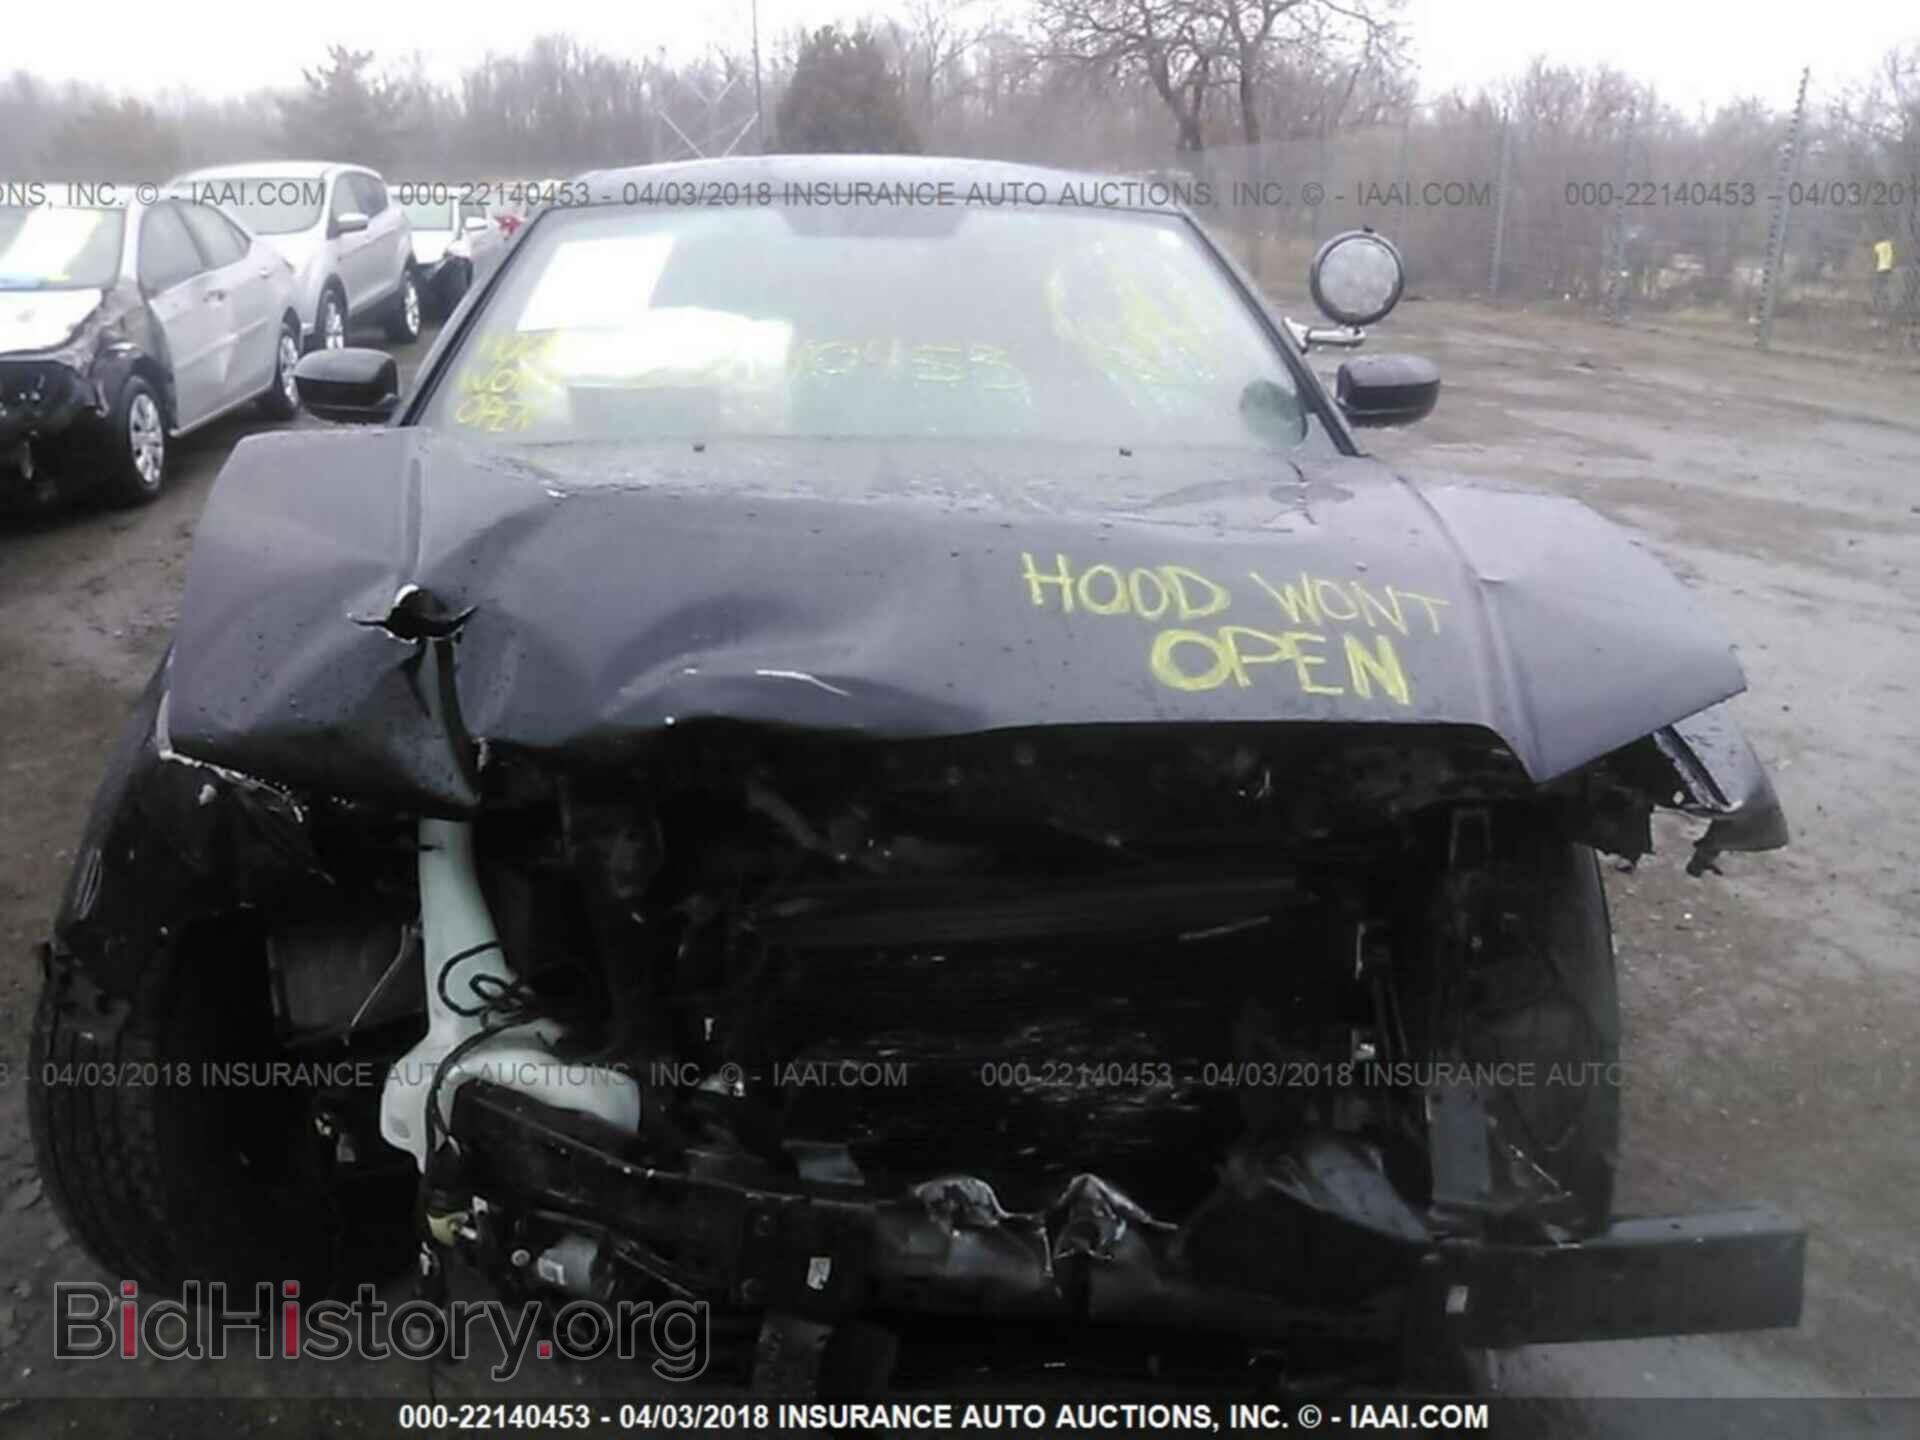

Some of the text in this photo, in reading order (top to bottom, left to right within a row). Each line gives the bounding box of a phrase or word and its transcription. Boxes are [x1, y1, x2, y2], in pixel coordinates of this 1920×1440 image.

[1022, 552, 1450, 636] HOOD WONT
[1150, 625, 1412, 705] OPEN
